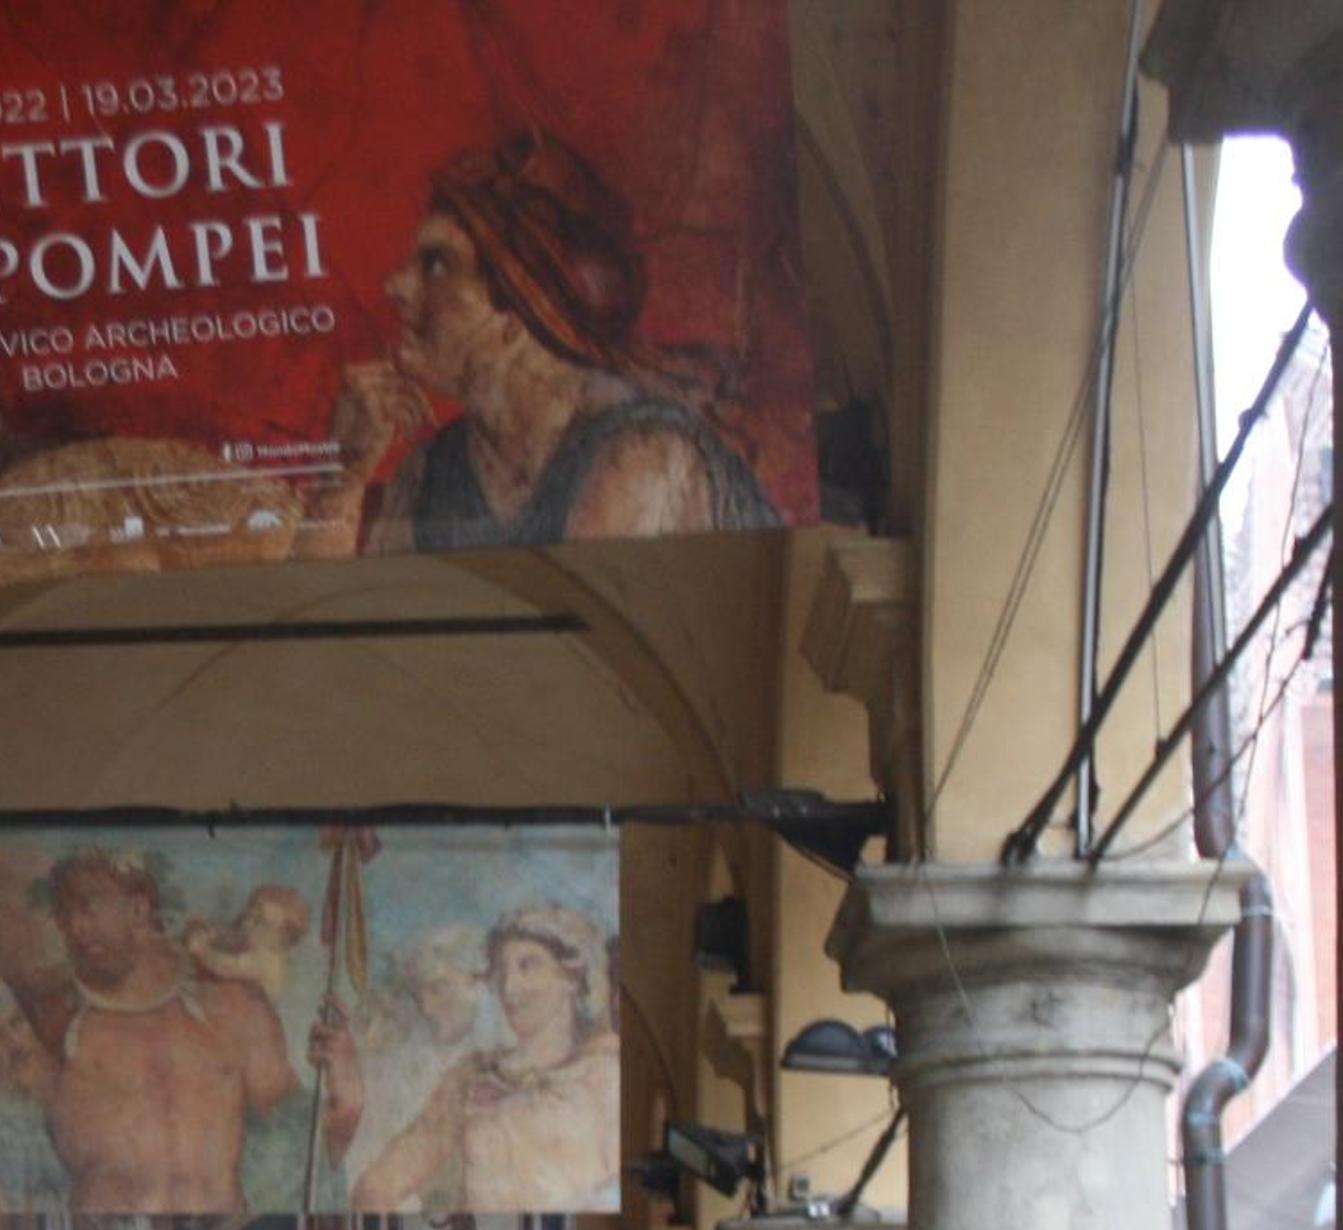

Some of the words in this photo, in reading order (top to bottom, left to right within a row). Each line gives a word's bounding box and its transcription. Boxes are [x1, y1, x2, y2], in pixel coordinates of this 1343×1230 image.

[82, 67, 284, 116] 19.03.2023
[84, 305, 337, 351] ARCHEOLOGICO
[22, 354, 179, 392] BOLOGNA
